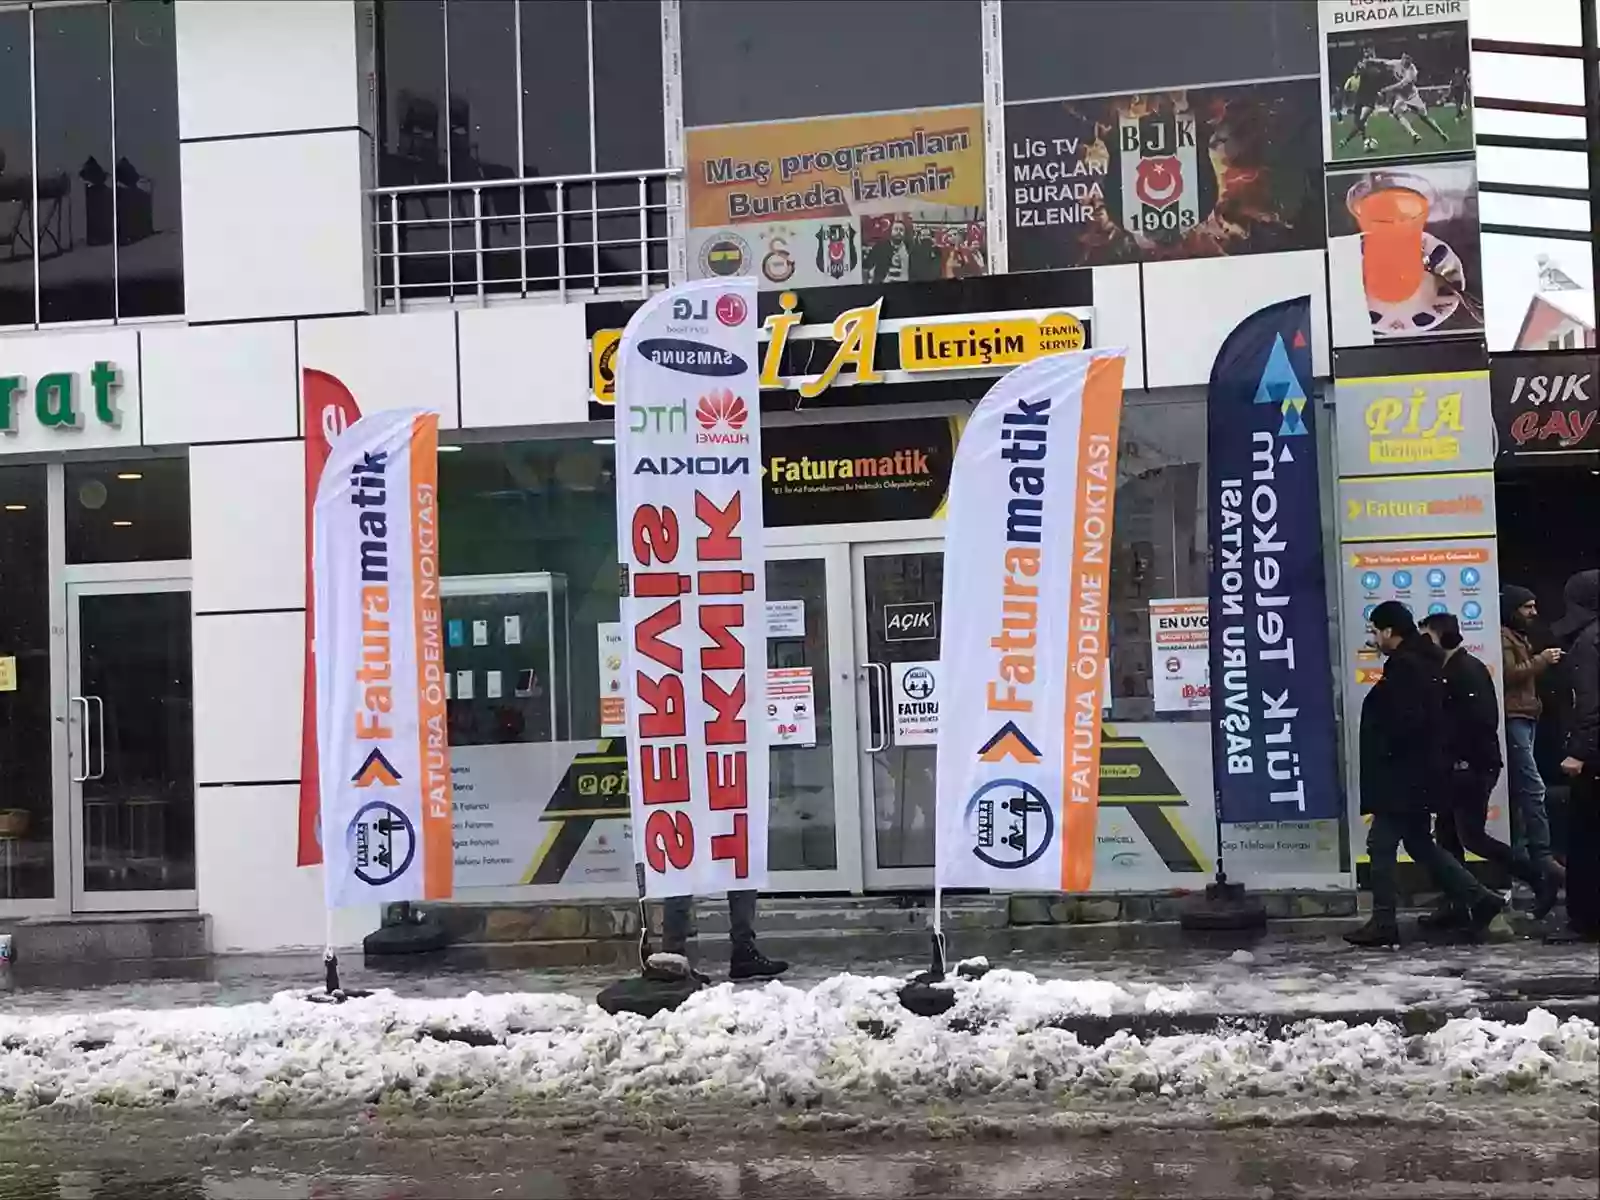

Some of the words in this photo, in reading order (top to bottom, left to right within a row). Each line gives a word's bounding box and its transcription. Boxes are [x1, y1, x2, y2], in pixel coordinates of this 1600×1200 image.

[1334, 9, 1399, 25] BURADA
[1013, 139, 1047, 159] LİG
[1052, 137, 1080, 155] TV
[1122, 118, 1197, 152] BJK
[705, 156, 772, 184] Maç
[780, 127, 971, 183] programları
[1014, 159, 1108, 184] MAÇLARI
[728, 182, 846, 218] Burada
[852, 163, 955, 200] İzlenir
[1015, 180, 1105, 205] BURADA
[1015, 202, 1096, 228] İZLENİR
[1129, 209, 1197, 234] 1903
[1510, 374, 1592, 406] IŞIK
[1365, 387, 1465, 440] PİA
[1511, 409, 1598, 448] ÇAY
[770, 449, 930, 482] Faturamatik
[1083, 434, 1111, 564] NOKTASI
[417, 483, 438, 600] NOKTASI
[986, 398, 1052, 712] Faturamatik
[351, 451, 393, 740] Faturamatik
[888, 612, 932, 632] AÇIK
[1072, 572, 1102, 679] ÖDEME
[1159, 618, 1178, 629] EN
[421, 608, 442, 705] ÖDEME
[1071, 690, 1097, 803] FATURA
[427, 714, 448, 819] FATURA
